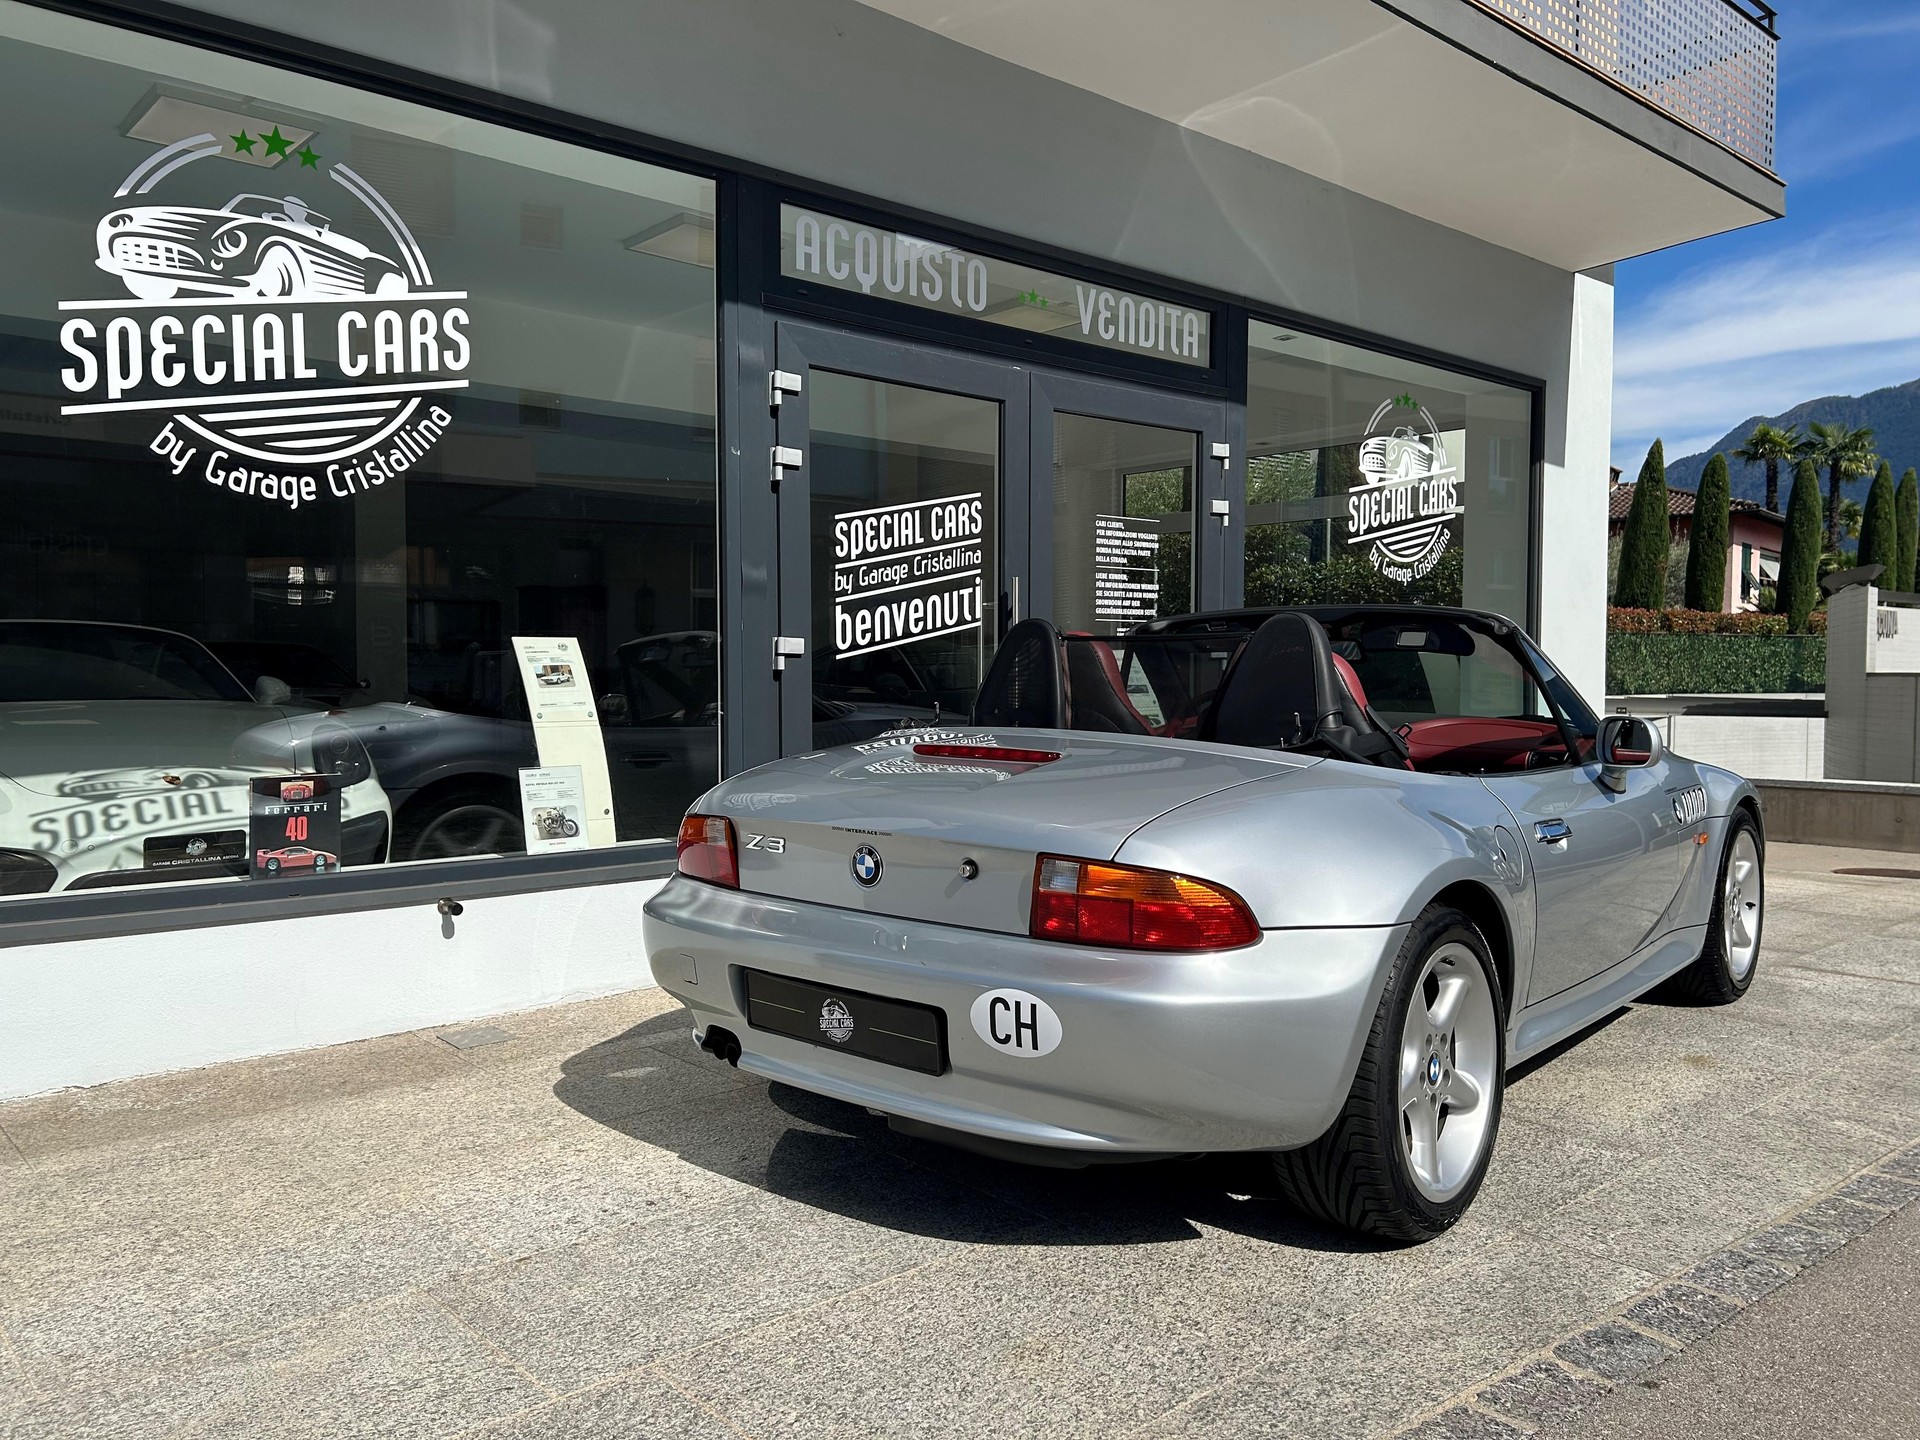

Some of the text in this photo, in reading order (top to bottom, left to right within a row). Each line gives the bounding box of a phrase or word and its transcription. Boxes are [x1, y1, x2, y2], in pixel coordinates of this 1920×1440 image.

[795, 215, 1199, 358] ACQUISTO VENDITA
[59, 307, 471, 400] SPECIAL CARS
[149, 404, 452, 510] by Garage Cristallina
[834, 500, 982, 560] SPECIAL CARS
[1349, 475, 1457, 535] SPECIAL CARS
[834, 548, 982, 594] by Garage Cristallina
[1369, 527, 1451, 586] by Garage Cristallina
[835, 576, 982, 650] benvenuti
[264, 802, 328, 815] Ferrari
[285, 816, 308, 841] 40
[171, 856, 222, 865] CRISTALLINA
[745, 833, 787, 855] Z3
[988, 996, 1039, 1052] CH
